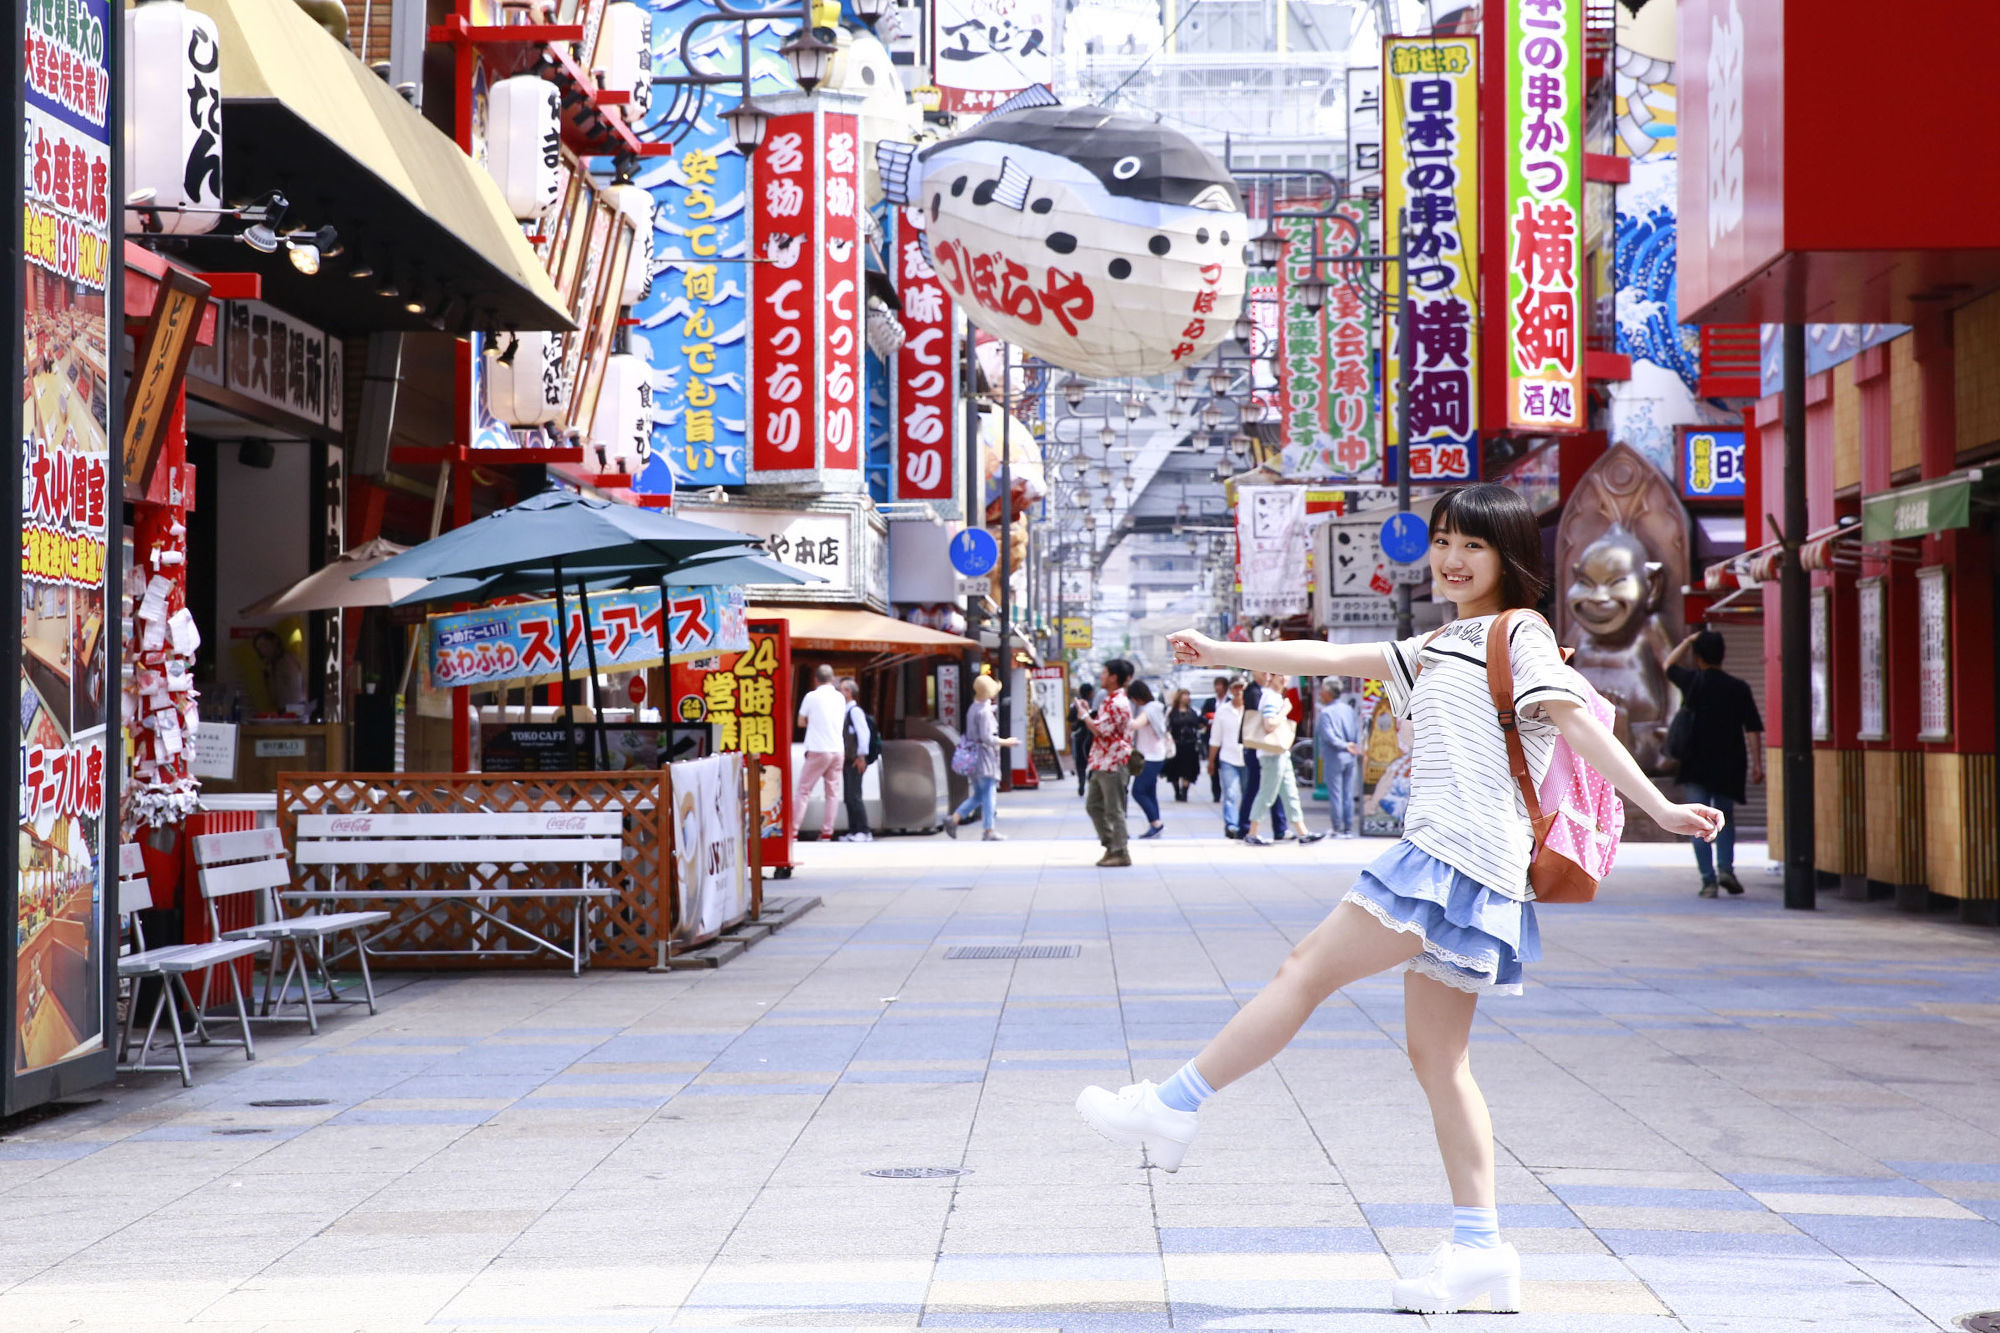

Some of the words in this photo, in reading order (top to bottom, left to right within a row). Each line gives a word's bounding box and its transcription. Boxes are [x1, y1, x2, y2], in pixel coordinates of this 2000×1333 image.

[940, 19, 1047, 61] エビス
[1392, 47, 1469, 74] 新世界
[34, 127, 107, 224] お座敷席
[766, 132, 804, 218] 名物
[826, 132, 855, 217] 名物
[1516, 202, 1574, 373] 横綱
[765, 279, 803, 452] てっちり
[826, 279, 855, 452] てっちり
[1523, 385, 1572, 417] 酒処
[1409, 448, 1466, 474] 酒処
[750, 533, 839, 565] や本店
[1459, 622, 1485, 648] Blue
[436, 646, 515, 678] ふわふわ
[512, 731, 537, 740] YOKO
[539, 731, 566, 740] CAFE
[28, 745, 102, 817] テーブル席
